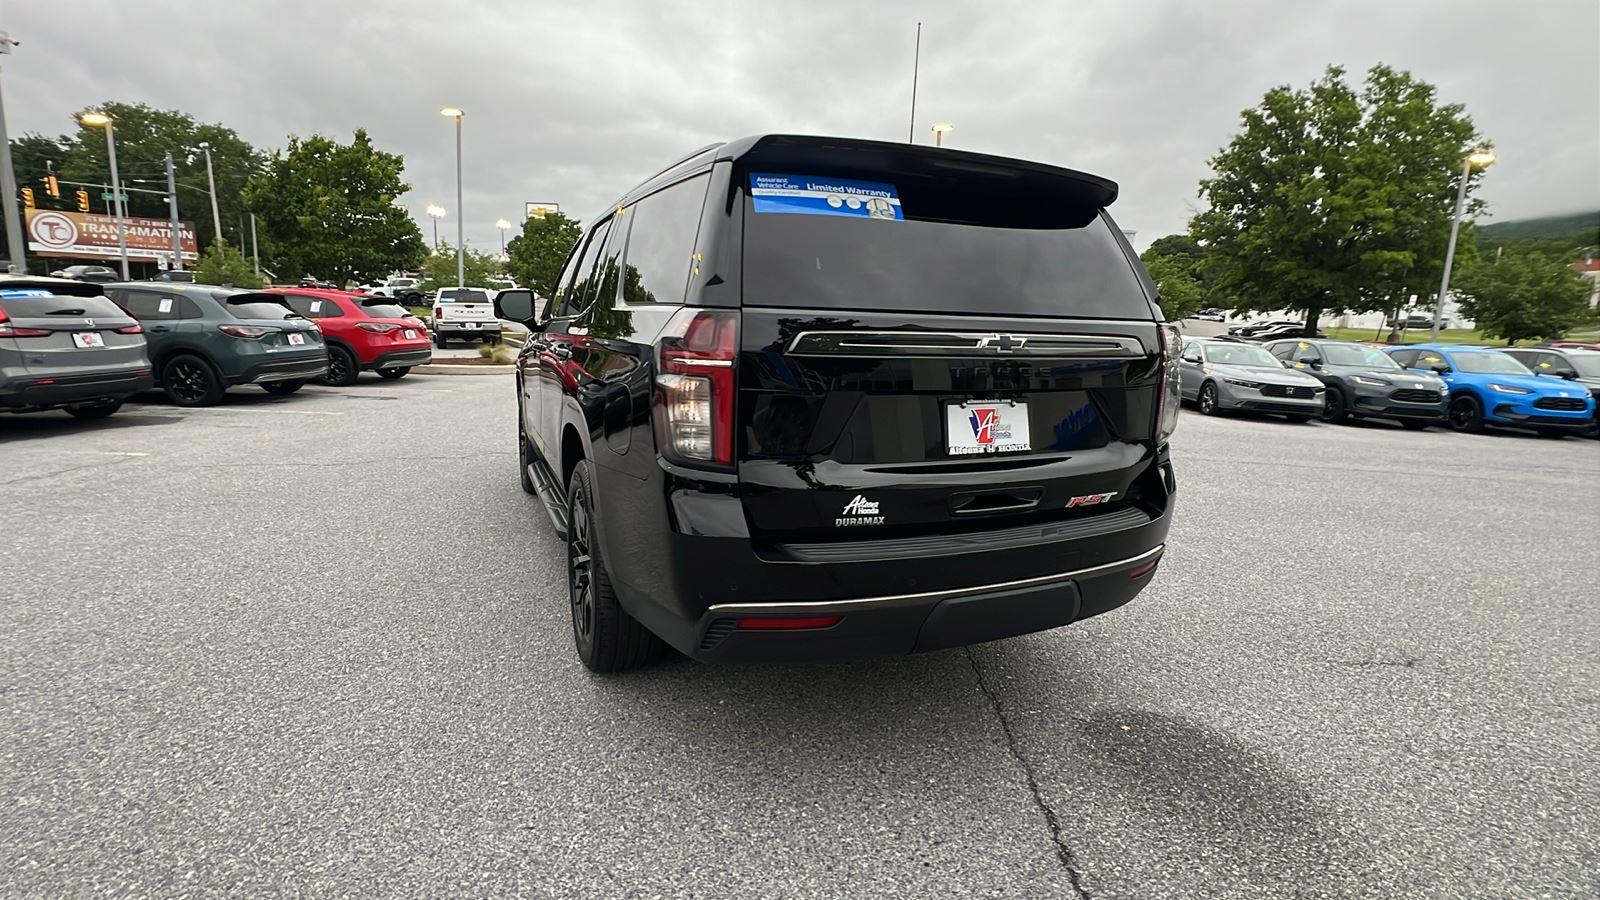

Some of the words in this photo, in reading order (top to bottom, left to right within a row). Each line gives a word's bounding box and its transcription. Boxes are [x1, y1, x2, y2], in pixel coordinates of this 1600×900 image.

[806, 183, 845, 194] Limited
[846, 186, 891, 198] Warranty
[123, 235, 194, 245] CHURH
[949, 446, 985, 455] Altoona
[999, 444, 1032, 453] HONDA
[1065, 491, 1118, 507] RST
[835, 516, 885, 527] DURAMAX
